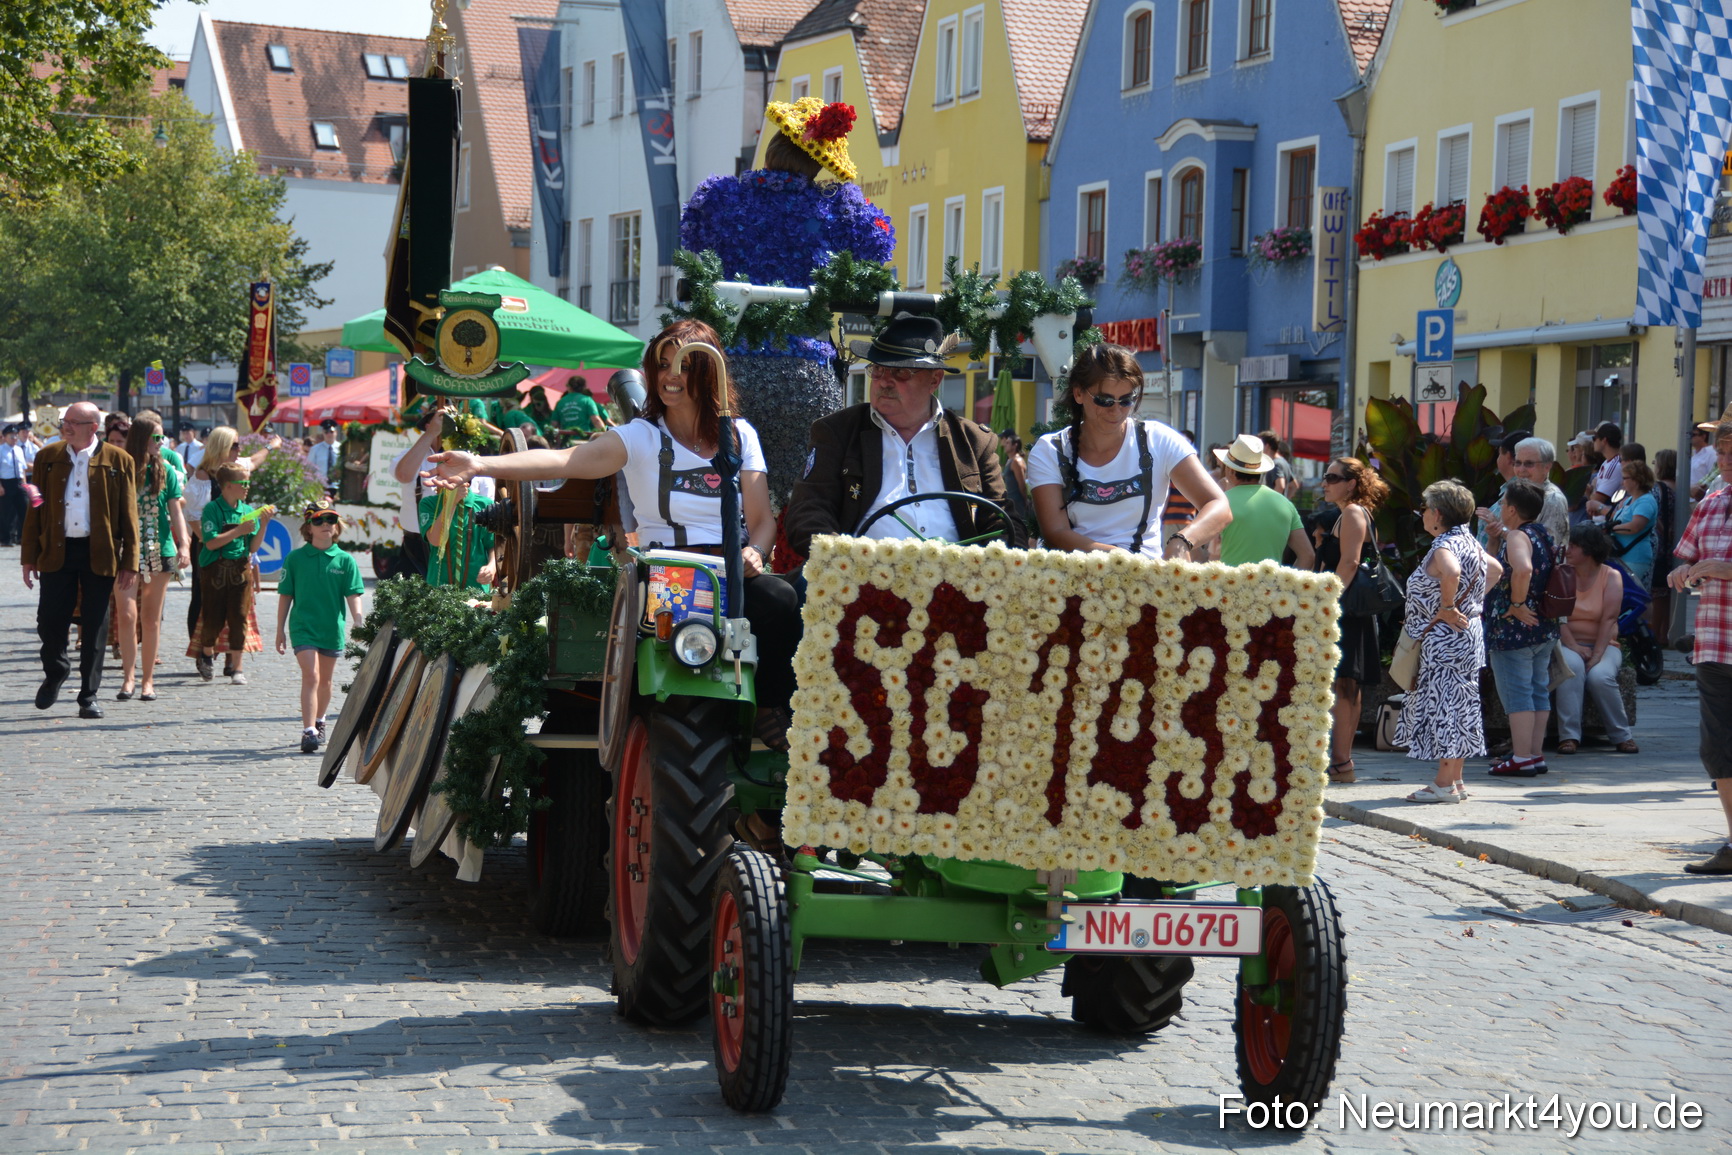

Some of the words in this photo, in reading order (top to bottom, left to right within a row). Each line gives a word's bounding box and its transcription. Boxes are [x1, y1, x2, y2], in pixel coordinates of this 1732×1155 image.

[1323, 215, 1343, 319] WITTL
[1437, 265, 1458, 308] FASS
[1702, 277, 1727, 299] ALTO
[497, 313, 555, 324] umarkter
[845, 323, 876, 333] TAIFU
[1424, 316, 1445, 357] P
[1428, 368, 1439, 377] nur
[148, 385, 163, 393] TAXI
[291, 385, 309, 394] TAXI
[432, 374, 504, 392] WOFFENBACH
[818, 581, 990, 815] SG
[1028, 595, 1296, 839] 1433
[1085, 910, 1131, 945] NM
[1152, 912, 1239, 948] 0670
